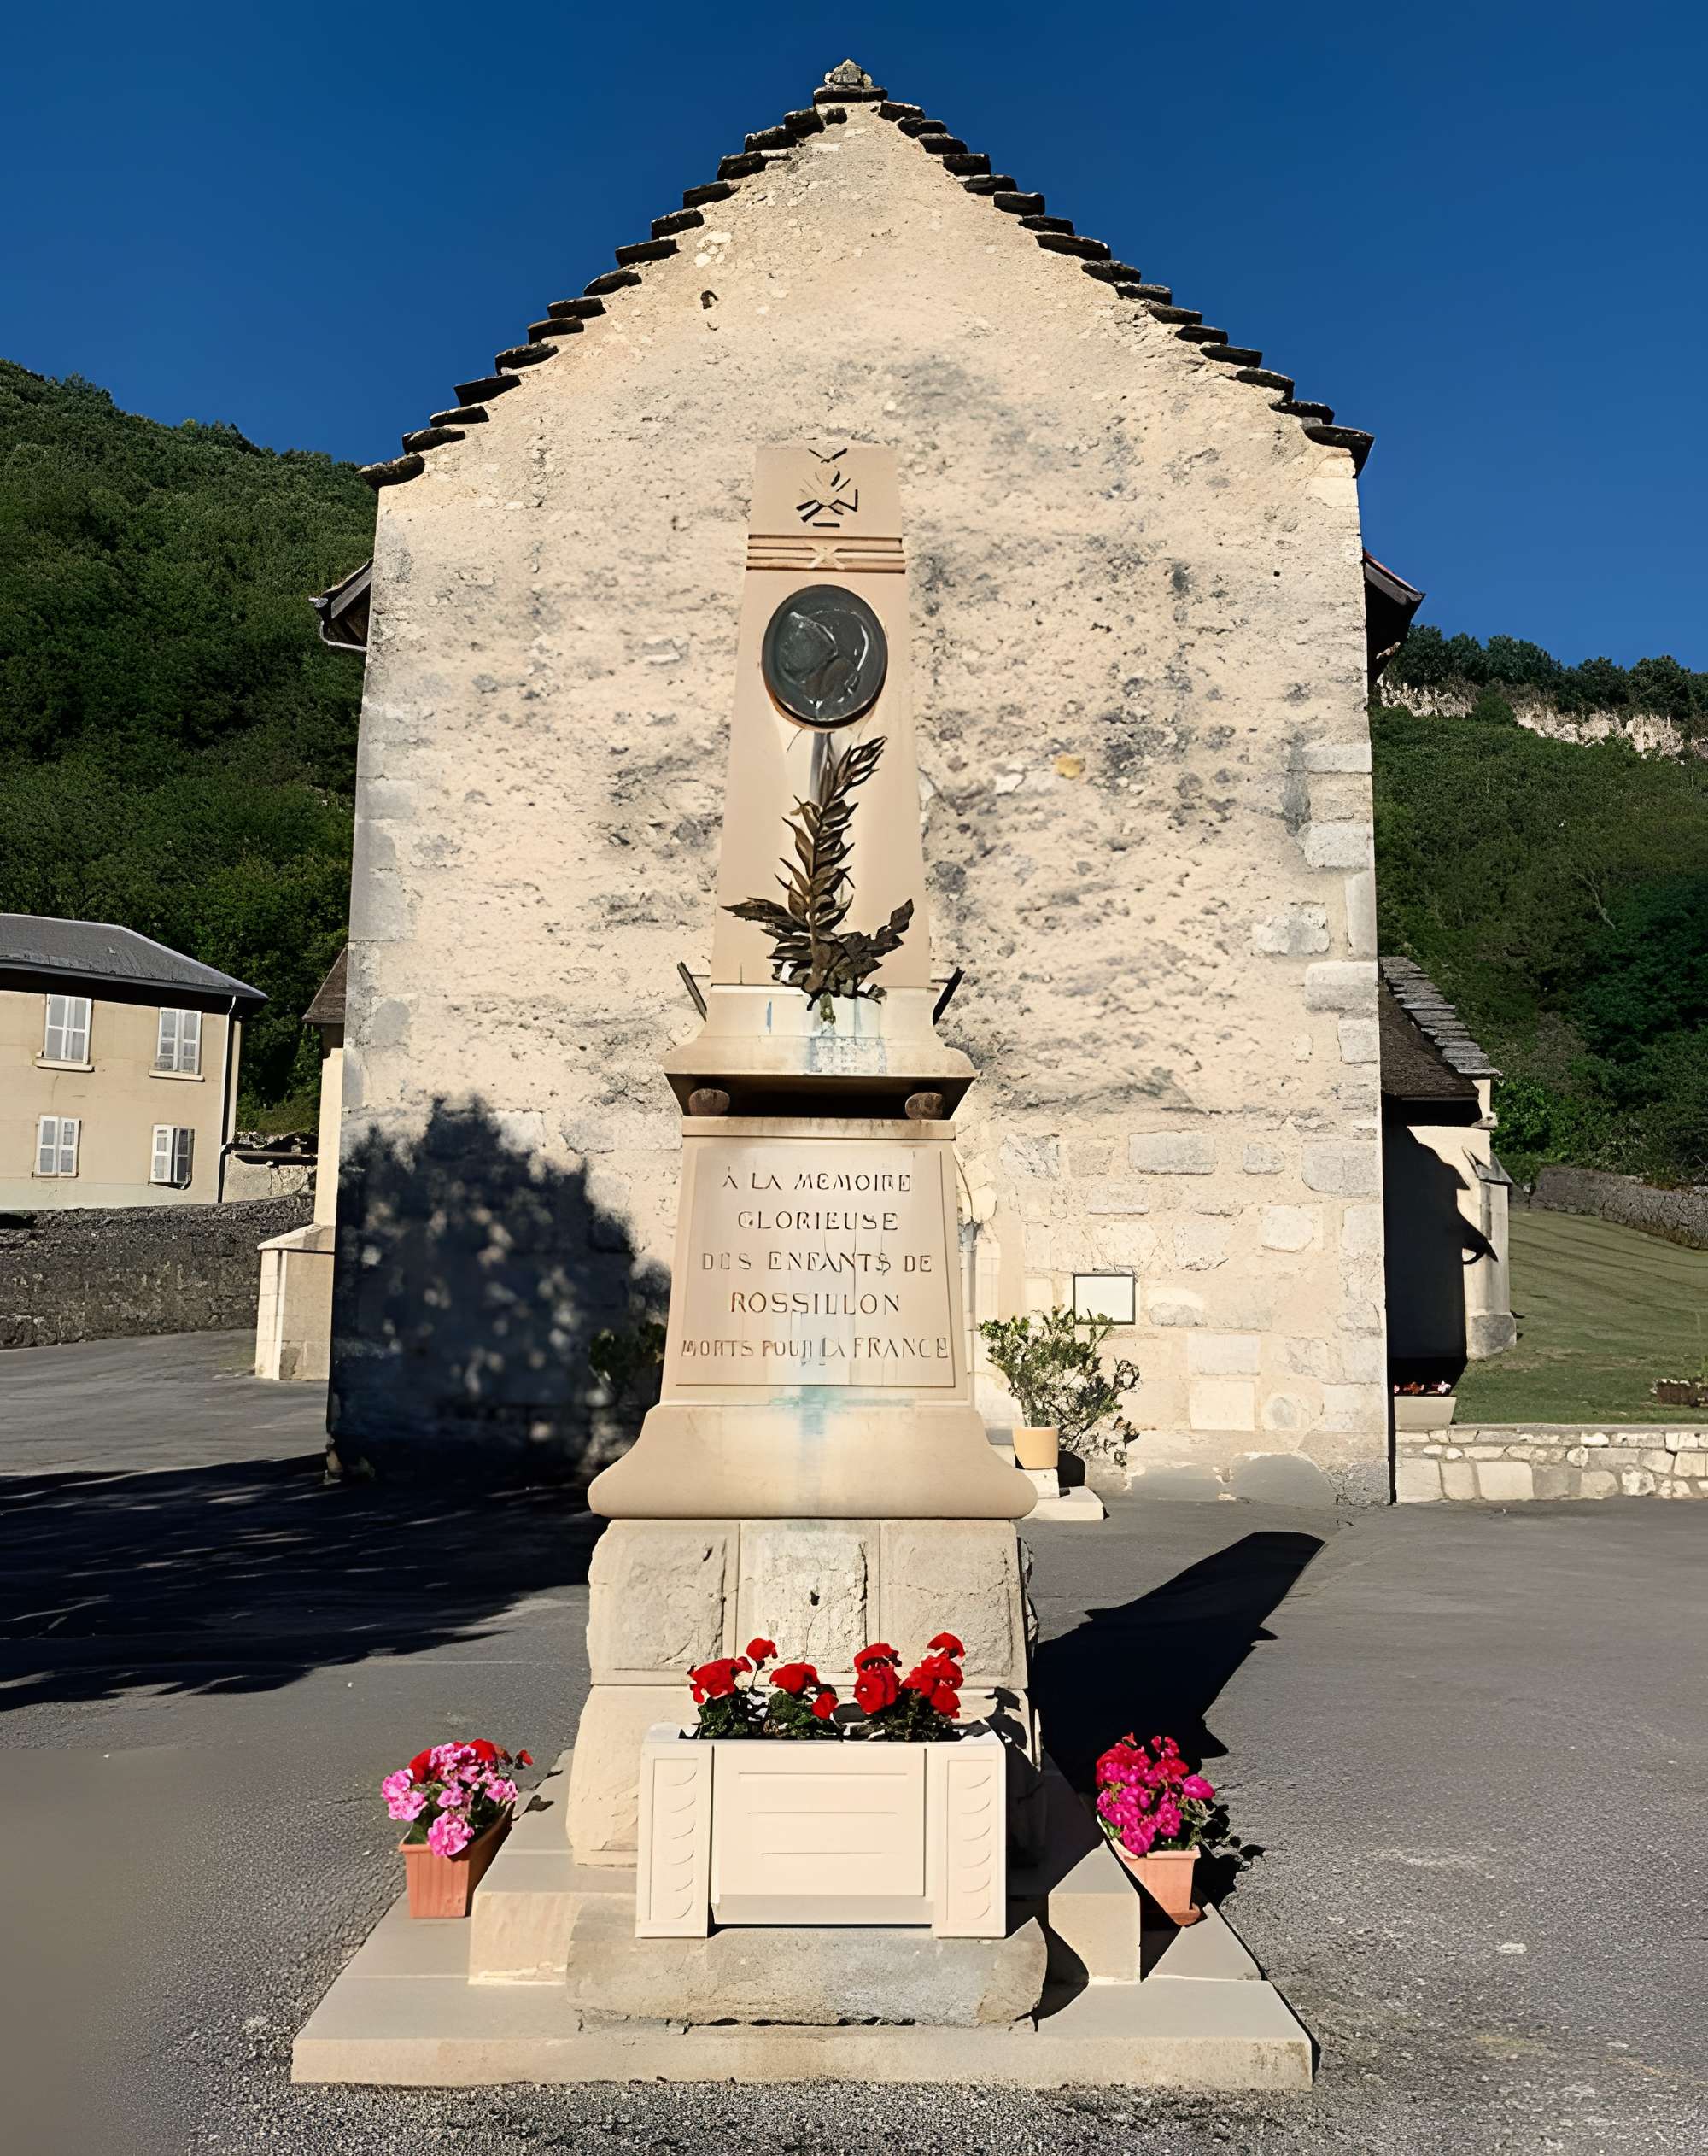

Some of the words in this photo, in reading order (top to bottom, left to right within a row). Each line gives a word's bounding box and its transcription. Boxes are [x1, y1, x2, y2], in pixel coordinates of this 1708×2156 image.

[752, 1172, 782, 1191] LA
[738, 1210, 898, 1231] GLORIEUSE
[702, 1252, 752, 1271] DES
[769, 1251, 891, 1273] ENFANTS
[904, 1255, 932, 1273] DE
[730, 1292, 899, 1315] ROSSILLON
[681, 1339, 753, 1357] MORTS
[762, 1339, 811, 1358] POUR
[820, 1337, 845, 1358] LA
[854, 1337, 949, 1359] FRANCE
